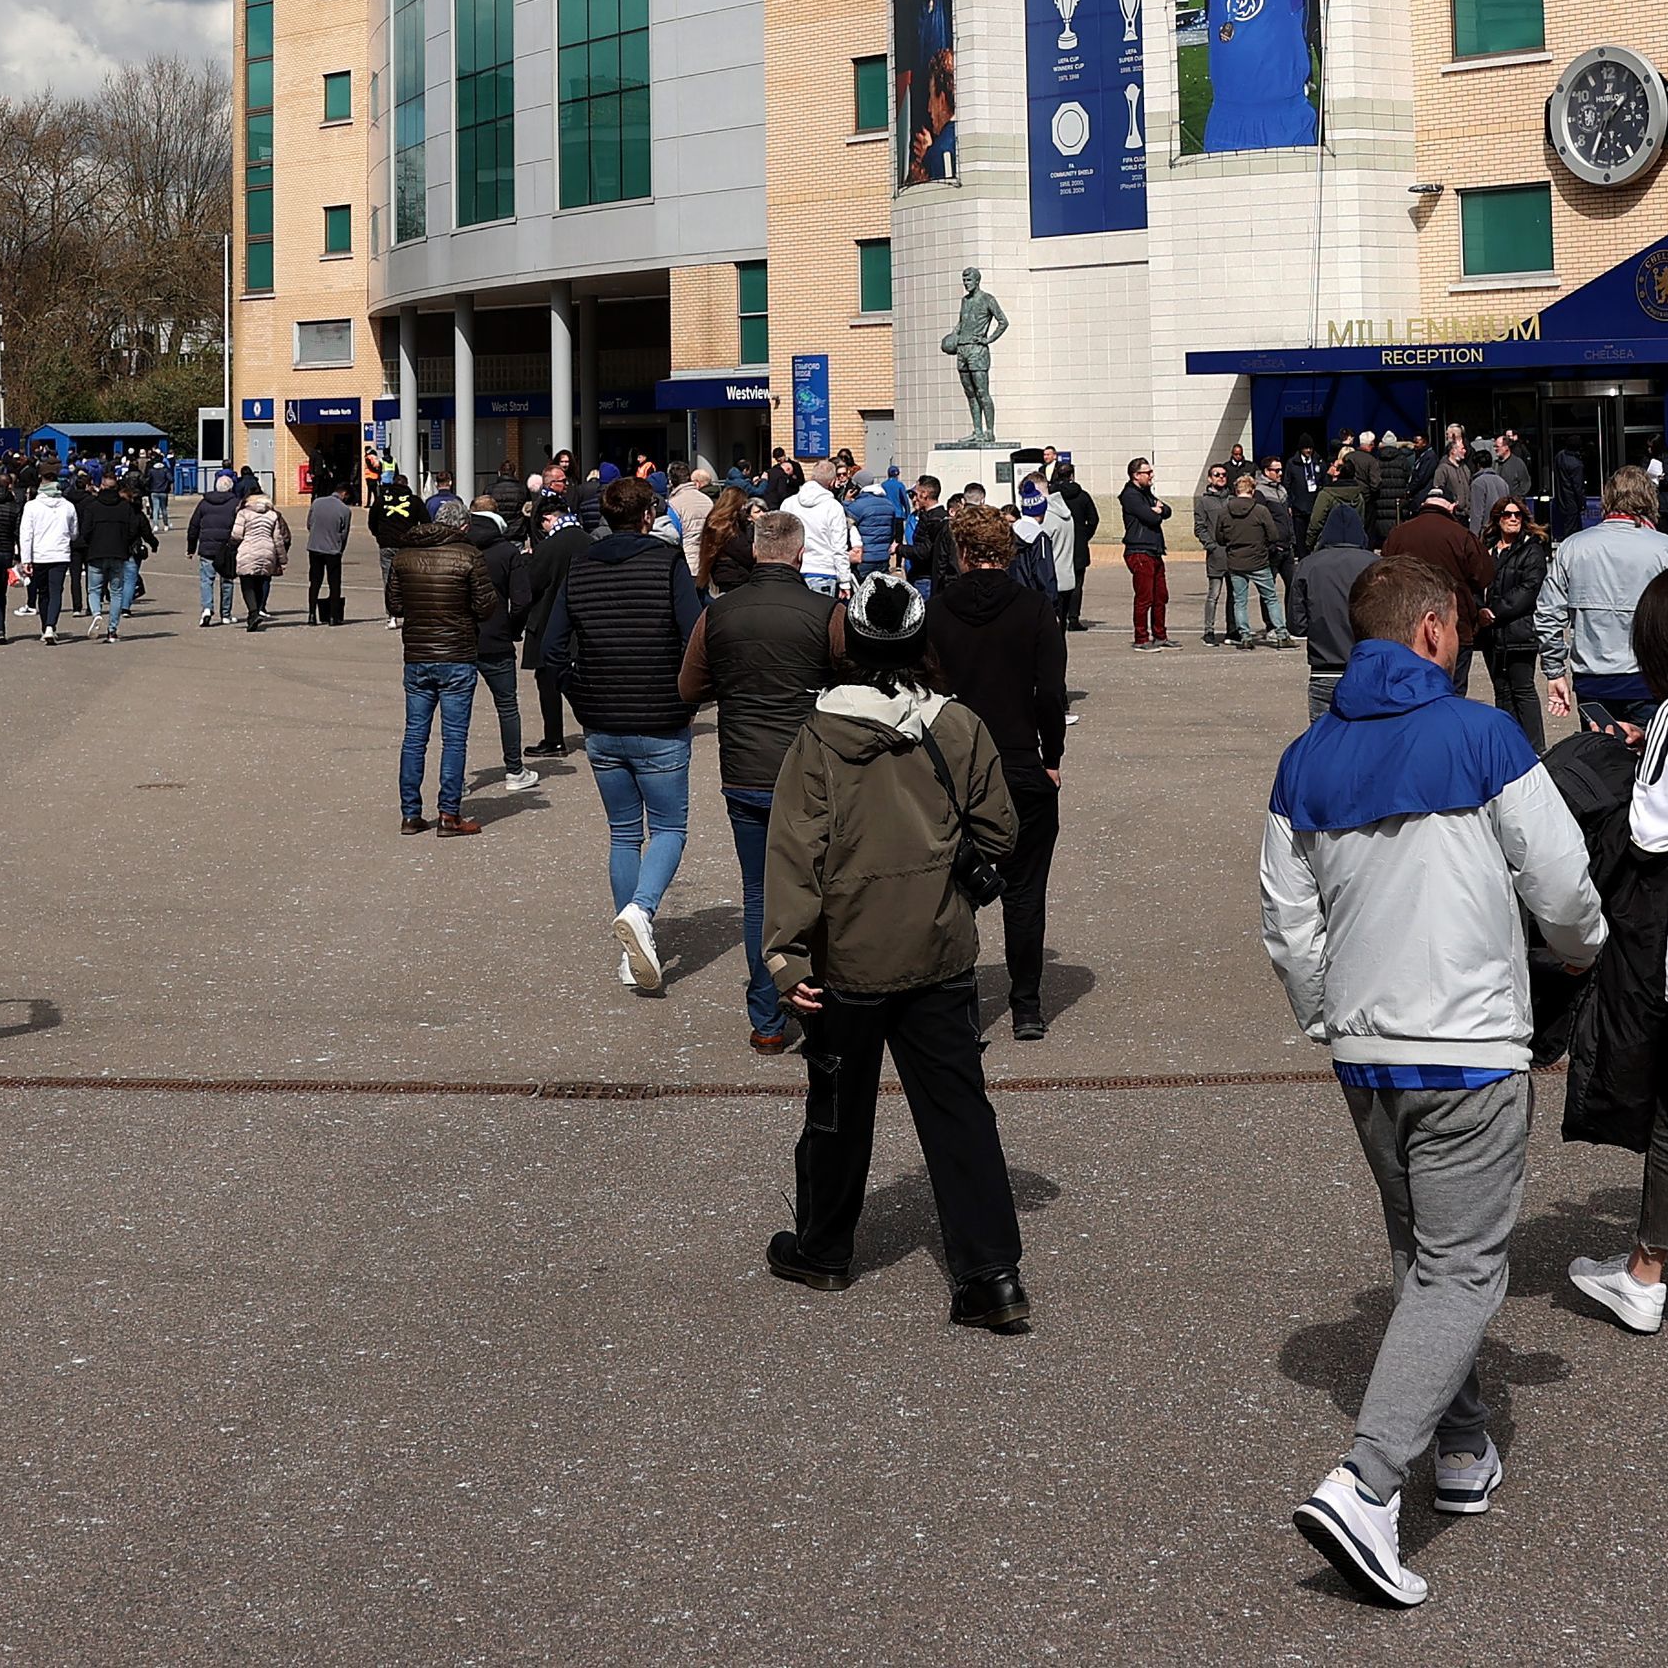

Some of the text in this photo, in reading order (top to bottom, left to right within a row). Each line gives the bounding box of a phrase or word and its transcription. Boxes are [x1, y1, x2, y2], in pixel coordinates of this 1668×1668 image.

[1600, 66, 1616, 80] 12
[1635, 84, 1644, 97] 2
[1577, 134, 1586, 147] 8
[1327, 312, 1542, 346] MILLENNIUM
[1381, 347, 1484, 365] RECEPTION
[726, 385, 770, 400] Westview
[491, 400, 529, 413] West Stand
